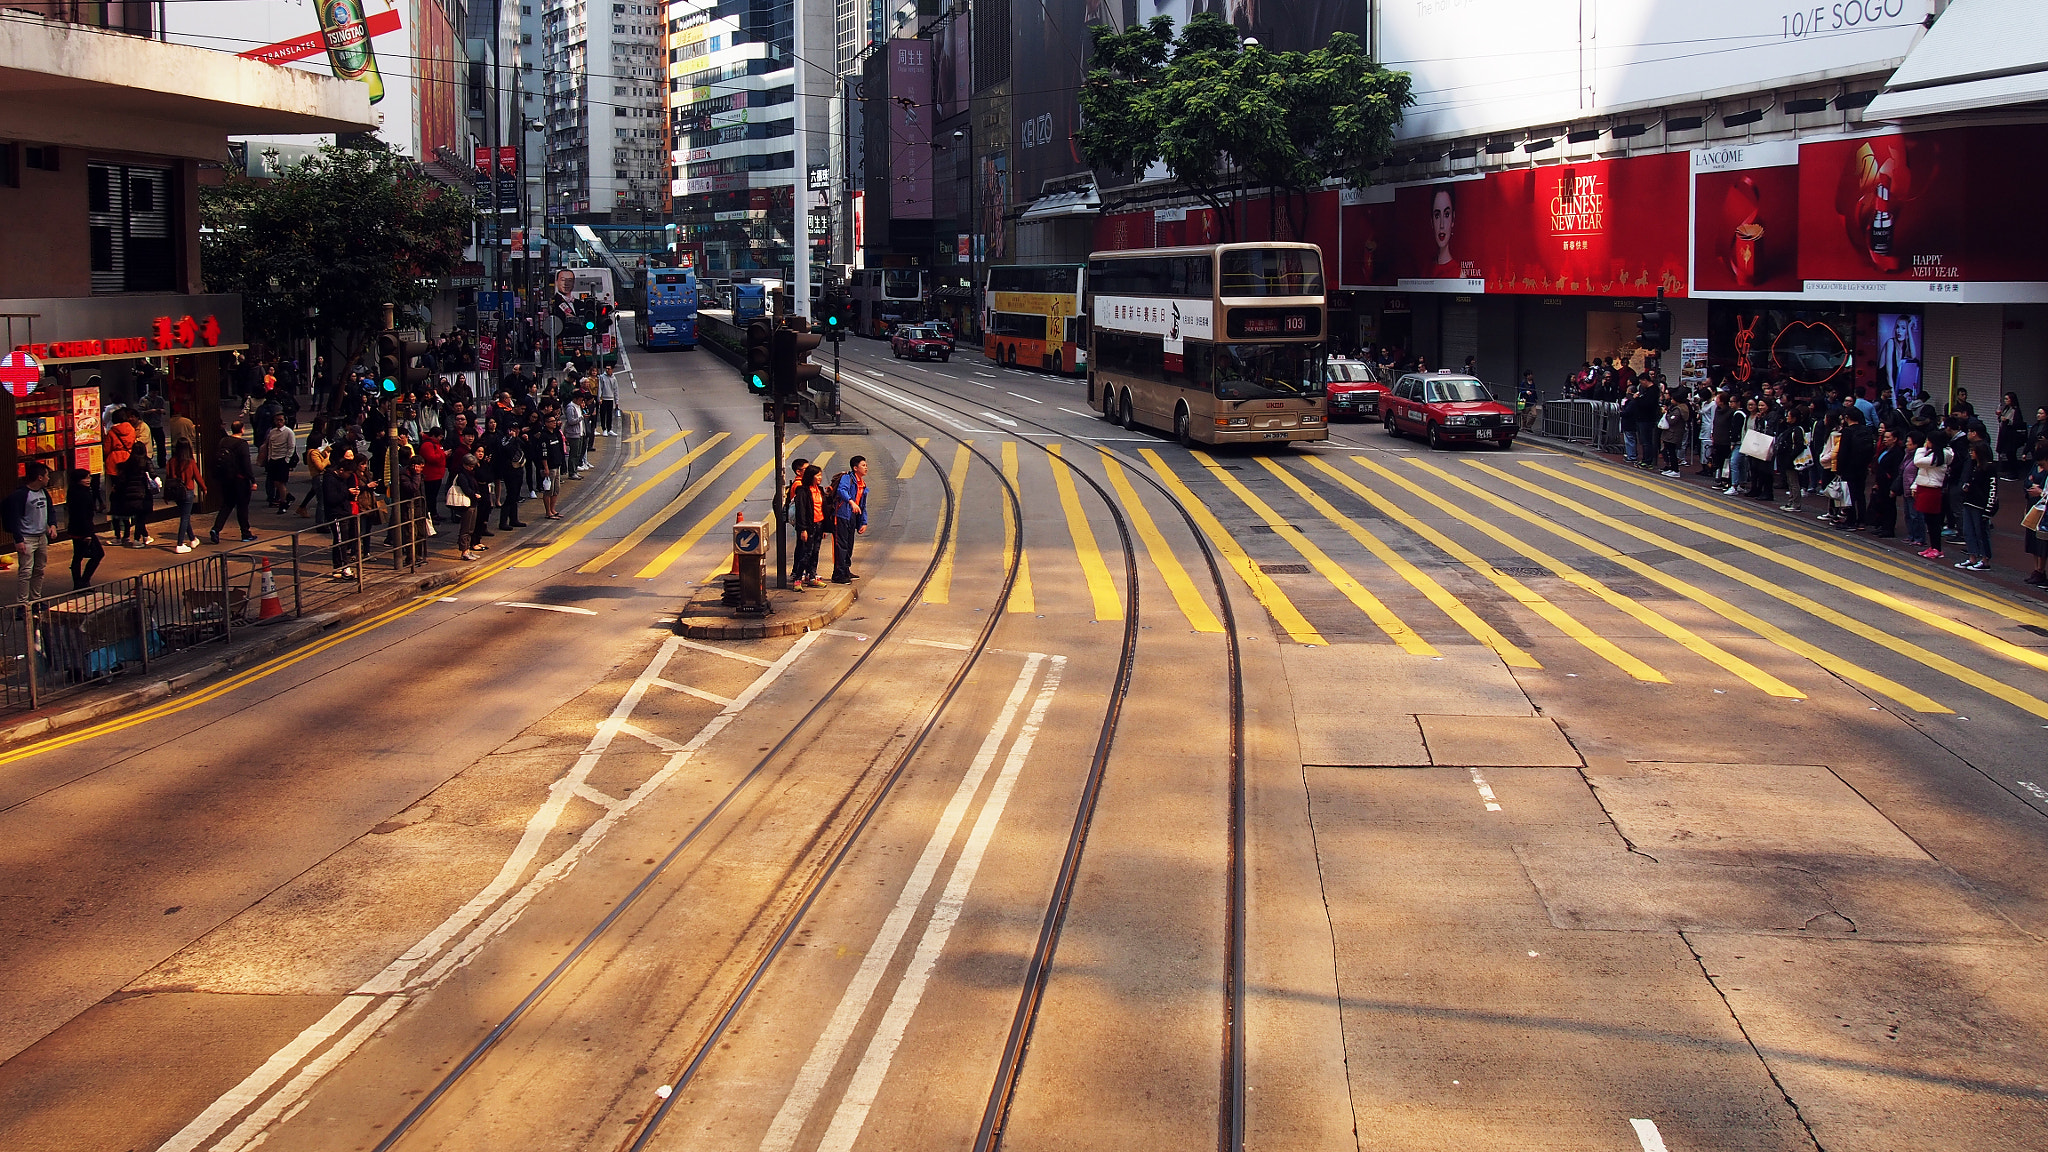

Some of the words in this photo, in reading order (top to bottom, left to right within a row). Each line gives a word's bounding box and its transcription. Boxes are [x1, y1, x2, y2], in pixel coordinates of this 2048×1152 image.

[1782, 7, 1825, 39] 10/F
[1832, 0, 1904, 29] SOGO
[327, 24, 365, 45] TSINGTAO
[262, 40, 316, 62] TRANSLATES
[898, 49, 924, 66] 周生生
[1022, 112, 1053, 150] KENZO
[1695, 148, 1744, 166] LANCÔME
[1558, 175, 1597, 197] HAPPY
[1550, 194, 1604, 216] CHINESE
[1551, 214, 1576, 231] NEW
[1577, 213, 1603, 230] YEAR
[1563, 240, 1588, 251] 新春快樂
[1913, 254, 1943, 266] HAPPY
[1912, 267, 1935, 278] NEW
[1287, 317, 1303, 330] 103
[52, 339, 102, 358] CHENG
[105, 337, 148, 354] HIANG
